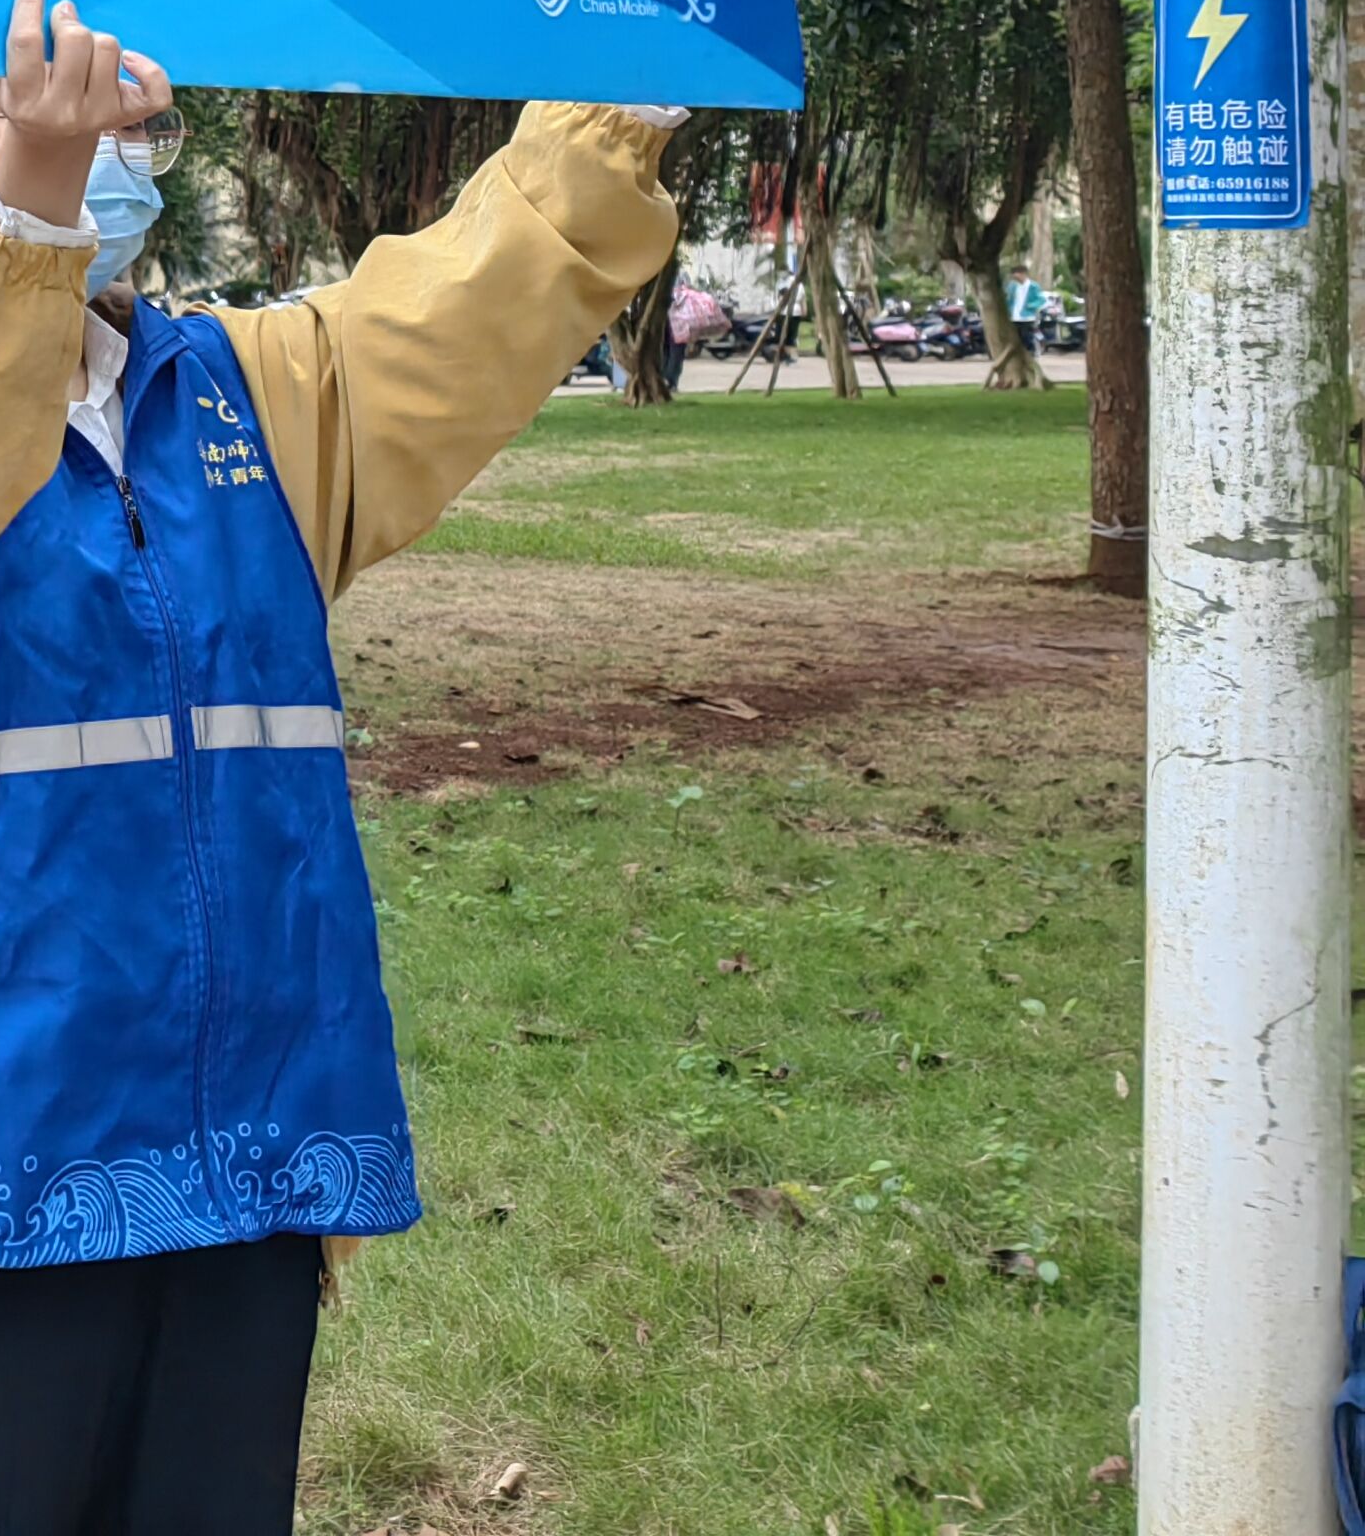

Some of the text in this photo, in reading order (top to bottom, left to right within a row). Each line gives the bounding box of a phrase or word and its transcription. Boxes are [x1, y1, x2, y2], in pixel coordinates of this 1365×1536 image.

[619, 0, 660, 17] Mobile
[1164, 98, 1289, 133] 有电危险
[1164, 133, 1290, 168] 请勿触碰
